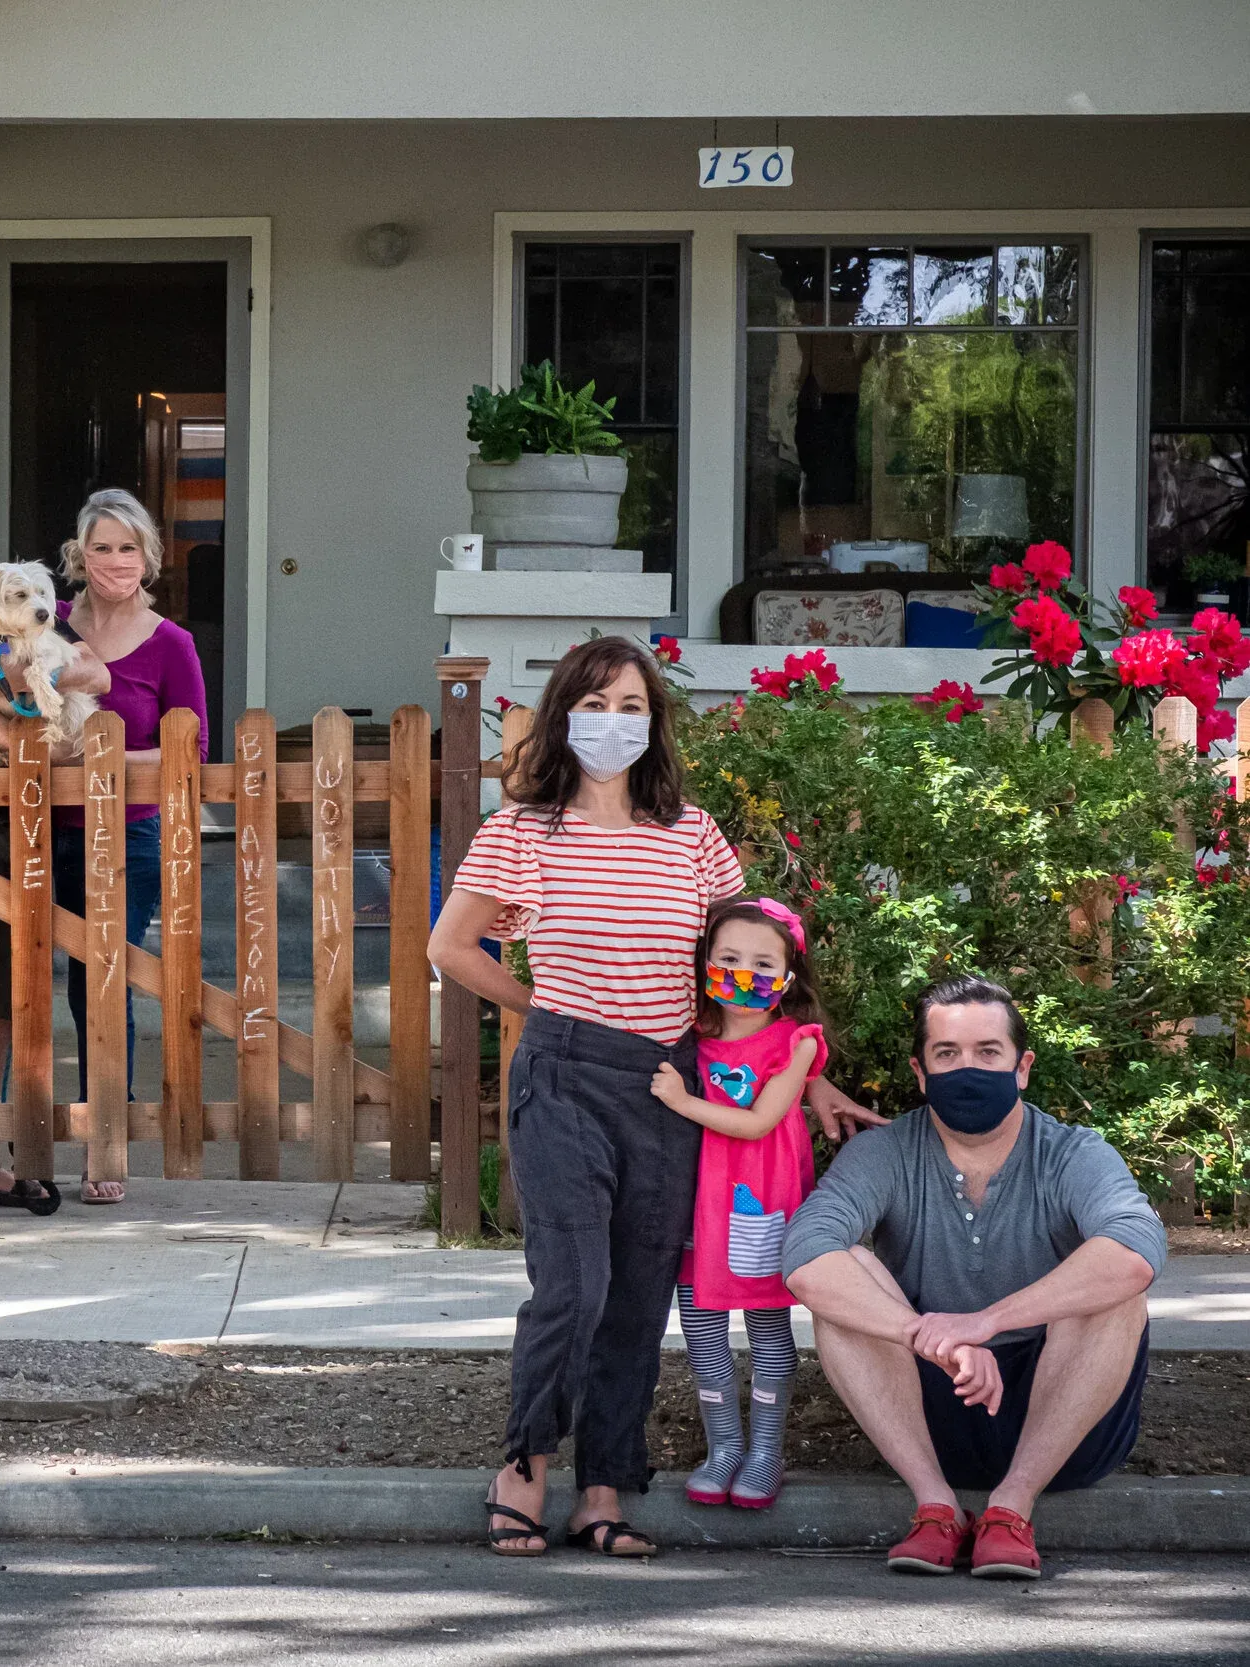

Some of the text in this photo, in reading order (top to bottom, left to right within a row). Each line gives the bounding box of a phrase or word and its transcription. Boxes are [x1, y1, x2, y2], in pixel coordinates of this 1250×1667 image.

[703, 149, 784, 184] 150
[18, 738, 46, 889] LOVE
[166, 788, 193, 935] HOPE
[240, 732, 271, 1041] BE AWESOME
[313, 751, 351, 985] WORTHY
